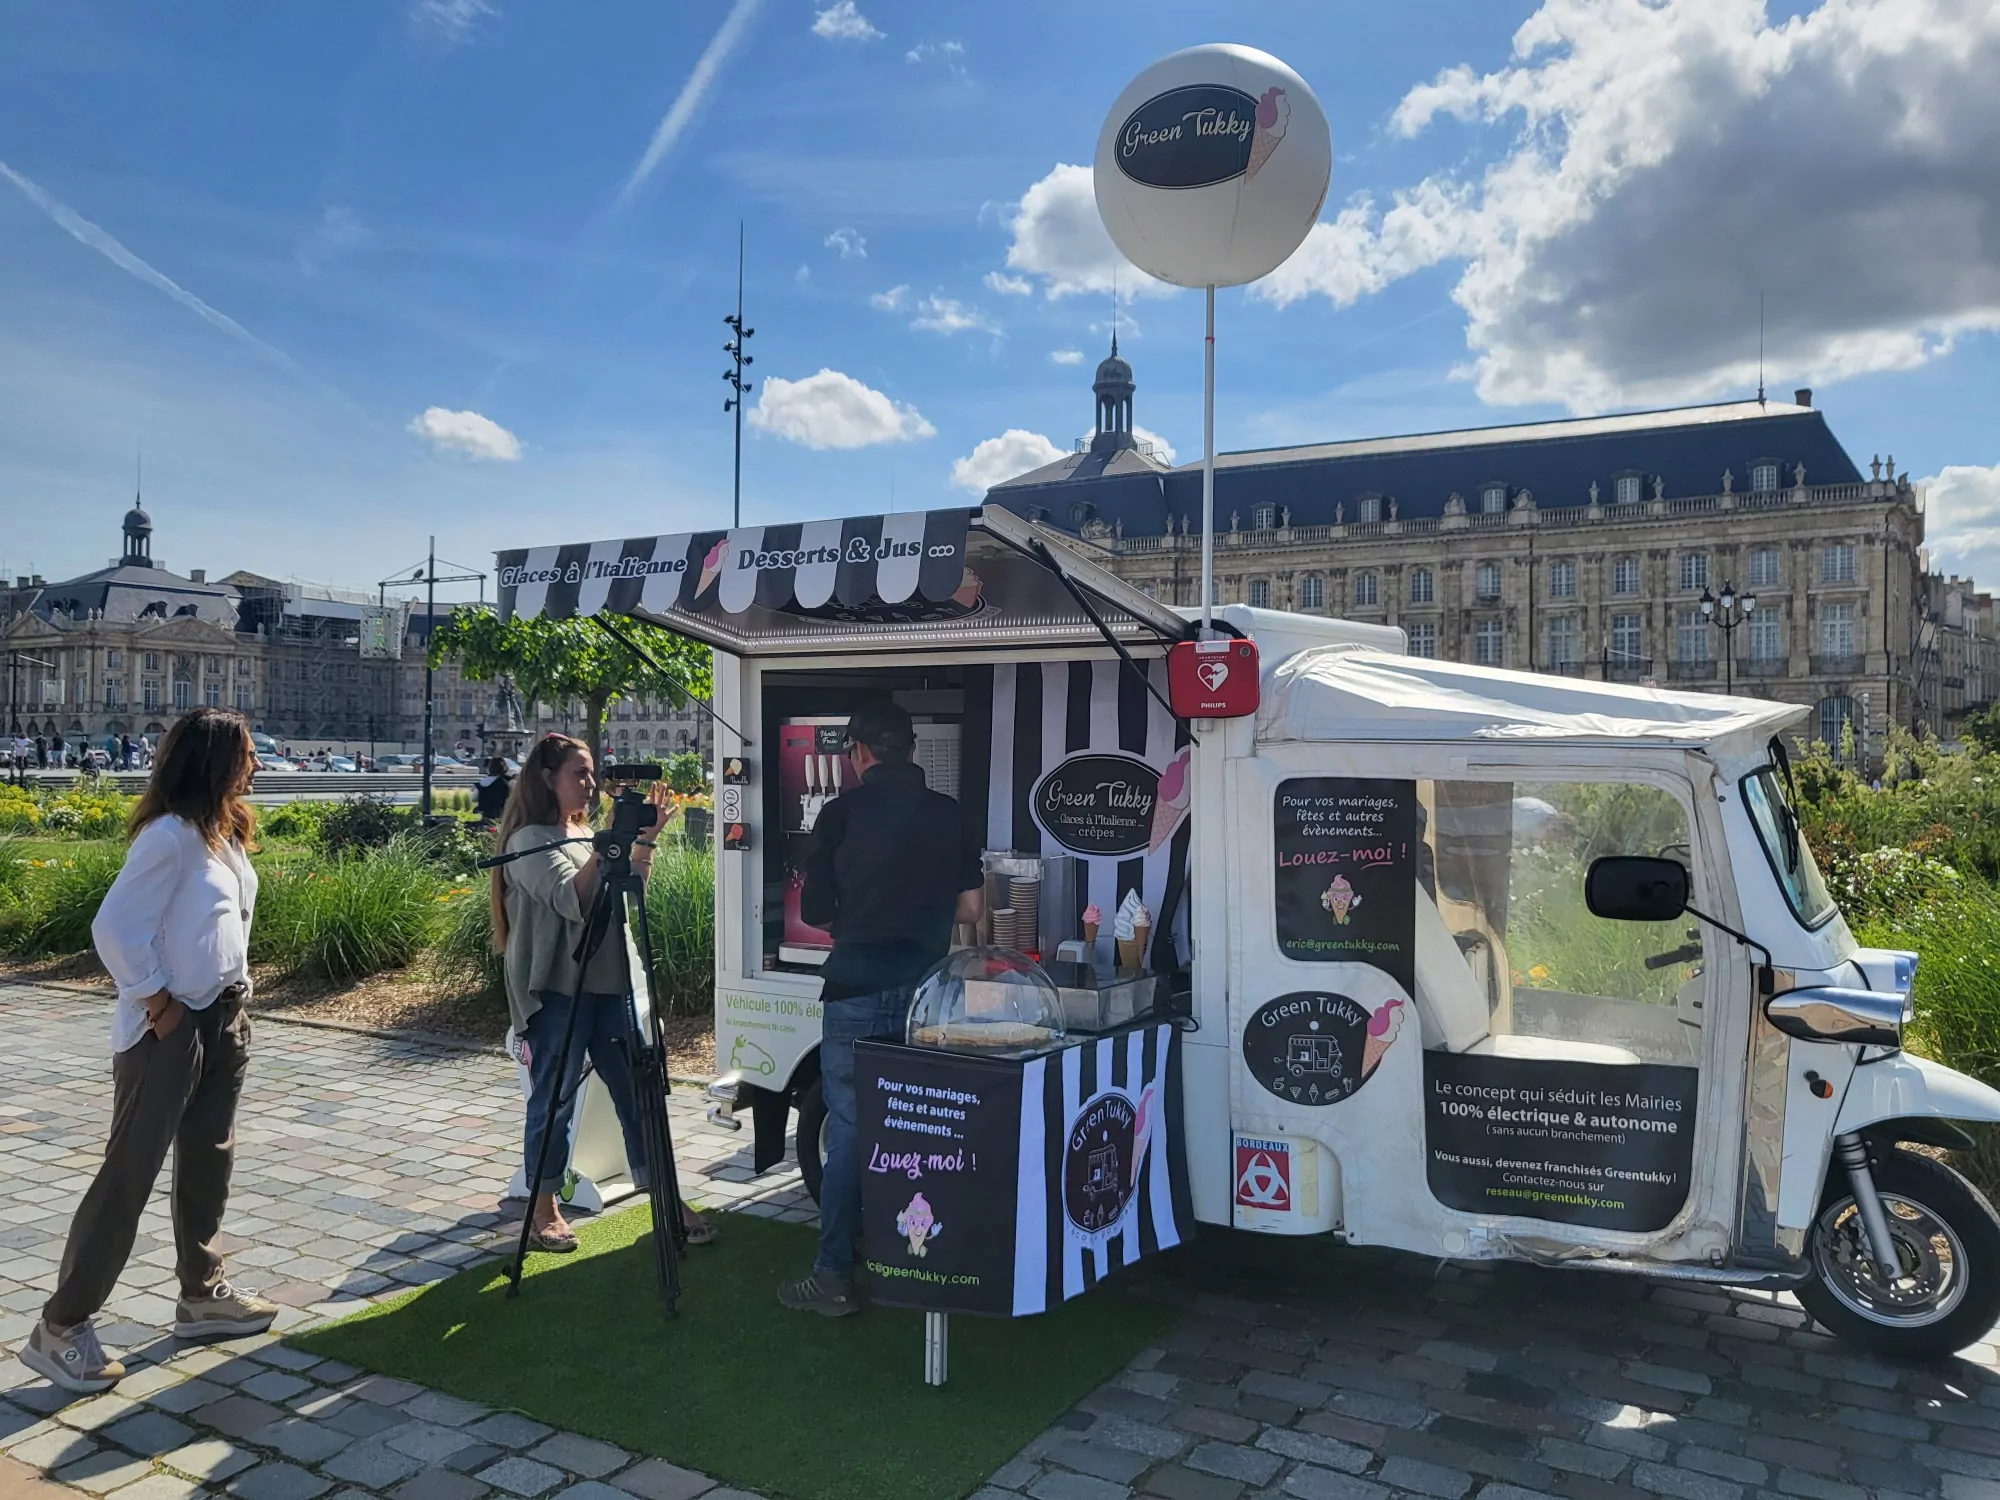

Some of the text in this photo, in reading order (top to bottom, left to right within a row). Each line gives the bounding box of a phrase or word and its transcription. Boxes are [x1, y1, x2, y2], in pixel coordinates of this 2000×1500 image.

[1123, 107, 1250, 157] Green Tukky
[737, 547, 841, 571] Desserts
[846, 536, 871, 562] &
[875, 537, 922, 561] Jus
[500, 556, 689, 587] Glaces à l'Italienne
[1045, 780, 1154, 816] Green Tukky
[1282, 795, 1398, 810] Pour vos mariages,
[1086, 813, 1093, 825] à
[1296, 808, 1384, 822] fêtes et autres
[1078, 826, 1115, 839] crêpes
[1279, 842, 1407, 867] Louez-moi !
[1286, 938, 1400, 953] eric@greentukky.com
[726, 994, 771, 1013] Véhicule
[774, 1000, 804, 1017] 100%
[1261, 996, 1363, 1027] Green Tukky
[878, 1077, 981, 1106] Pour vos mariages,
[1435, 1080, 1682, 1112] Le concept qui séduit les Mairies
[887, 1096, 966, 1121] fêtes et autres
[1105, 1100, 1132, 1130] Tukky
[1440, 1101, 1678, 1134] 100% électrique & autonome
[884, 1114, 952, 1138] évènements
[1516, 1127, 1548, 1138] aucun
[1551, 1128, 1626, 1145] branchement)
[1236, 1138, 1289, 1152] BORDEAUX
[868, 1142, 977, 1180] Louez-moi !
[1434, 1150, 1461, 1163] Vous
[1462, 1156, 1493, 1169] aussi,
[1495, 1157, 1542, 1171] devenez
[1544, 1161, 1602, 1177] franchisés
[1502, 1172, 1605, 1193] Contactez-nous sur
[1486, 1187, 1625, 1210] reseau@greentukky.com
